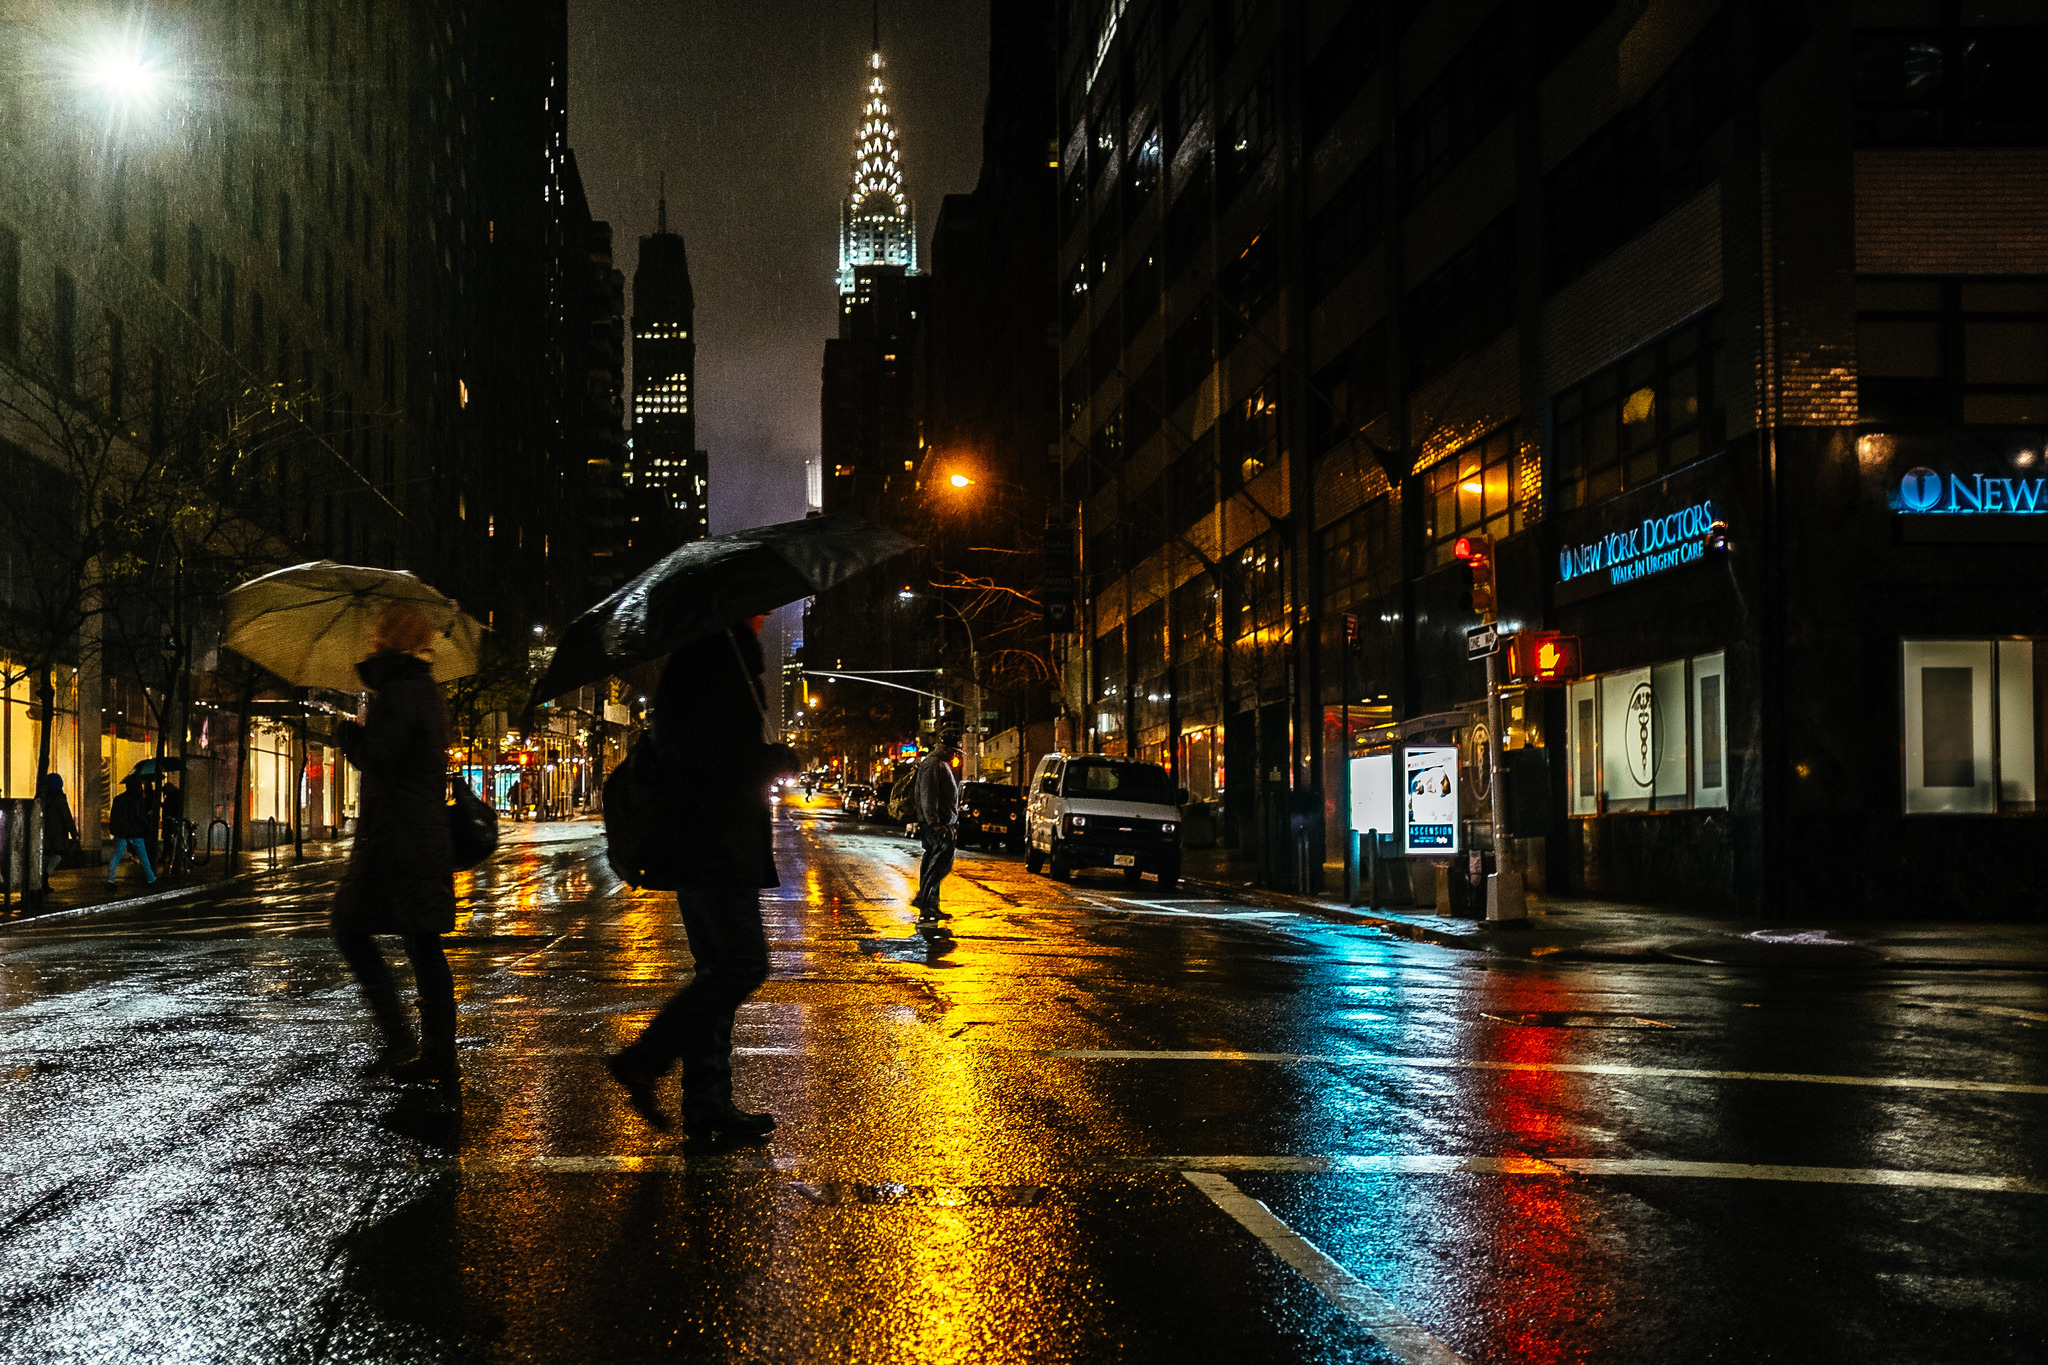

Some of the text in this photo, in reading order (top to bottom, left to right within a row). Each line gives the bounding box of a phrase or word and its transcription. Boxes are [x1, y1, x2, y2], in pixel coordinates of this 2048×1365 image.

[1948, 473, 2045, 511] NEW
[1572, 499, 1714, 577] NEW YORK DOCTORS
[1611, 540, 1704, 585] WALK-IN URGENT CARE
[1410, 826, 1452, 835] ASCENSION
